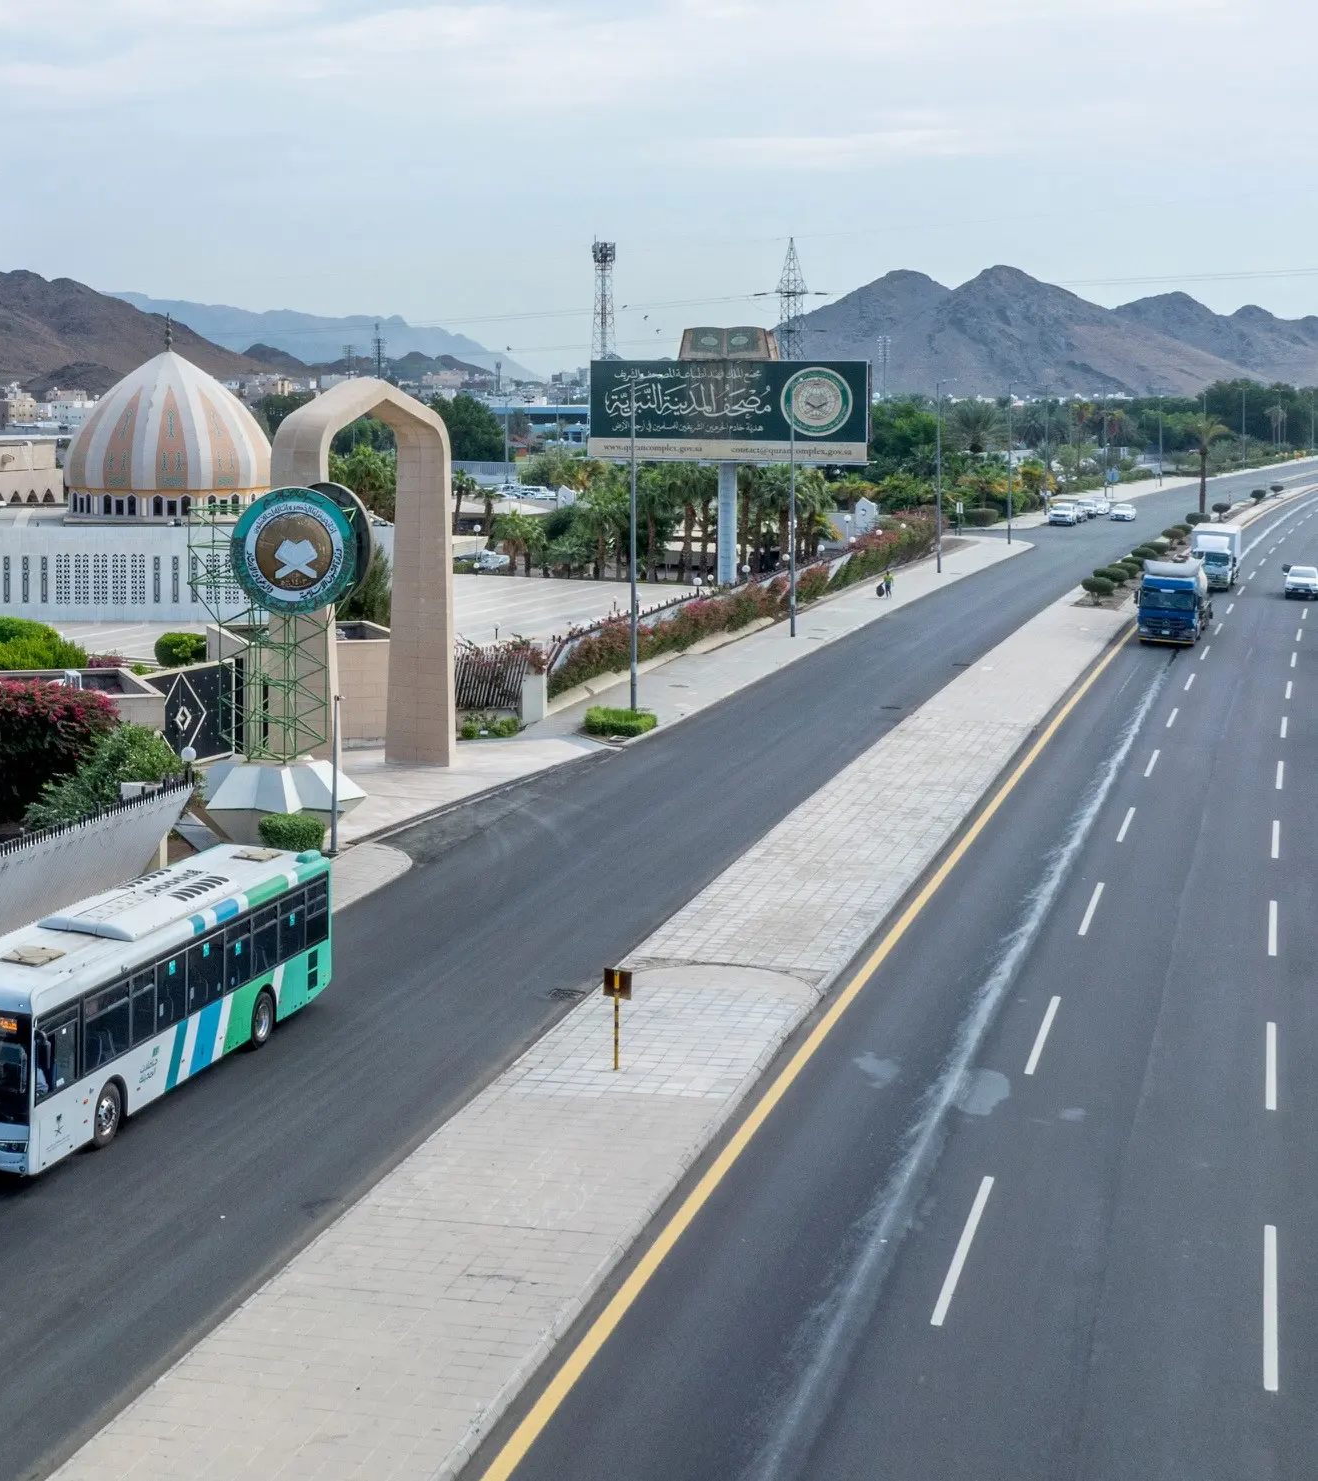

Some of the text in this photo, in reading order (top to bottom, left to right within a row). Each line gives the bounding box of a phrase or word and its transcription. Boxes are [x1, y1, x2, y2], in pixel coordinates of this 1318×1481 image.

[708, 368, 724, 380] فهد
[726, 366, 744, 379] الملك
[603, 443, 703, 454] www.quancomplex.gov.sa
[731, 446, 852, 457] contact@quranomplex.gov.sa
